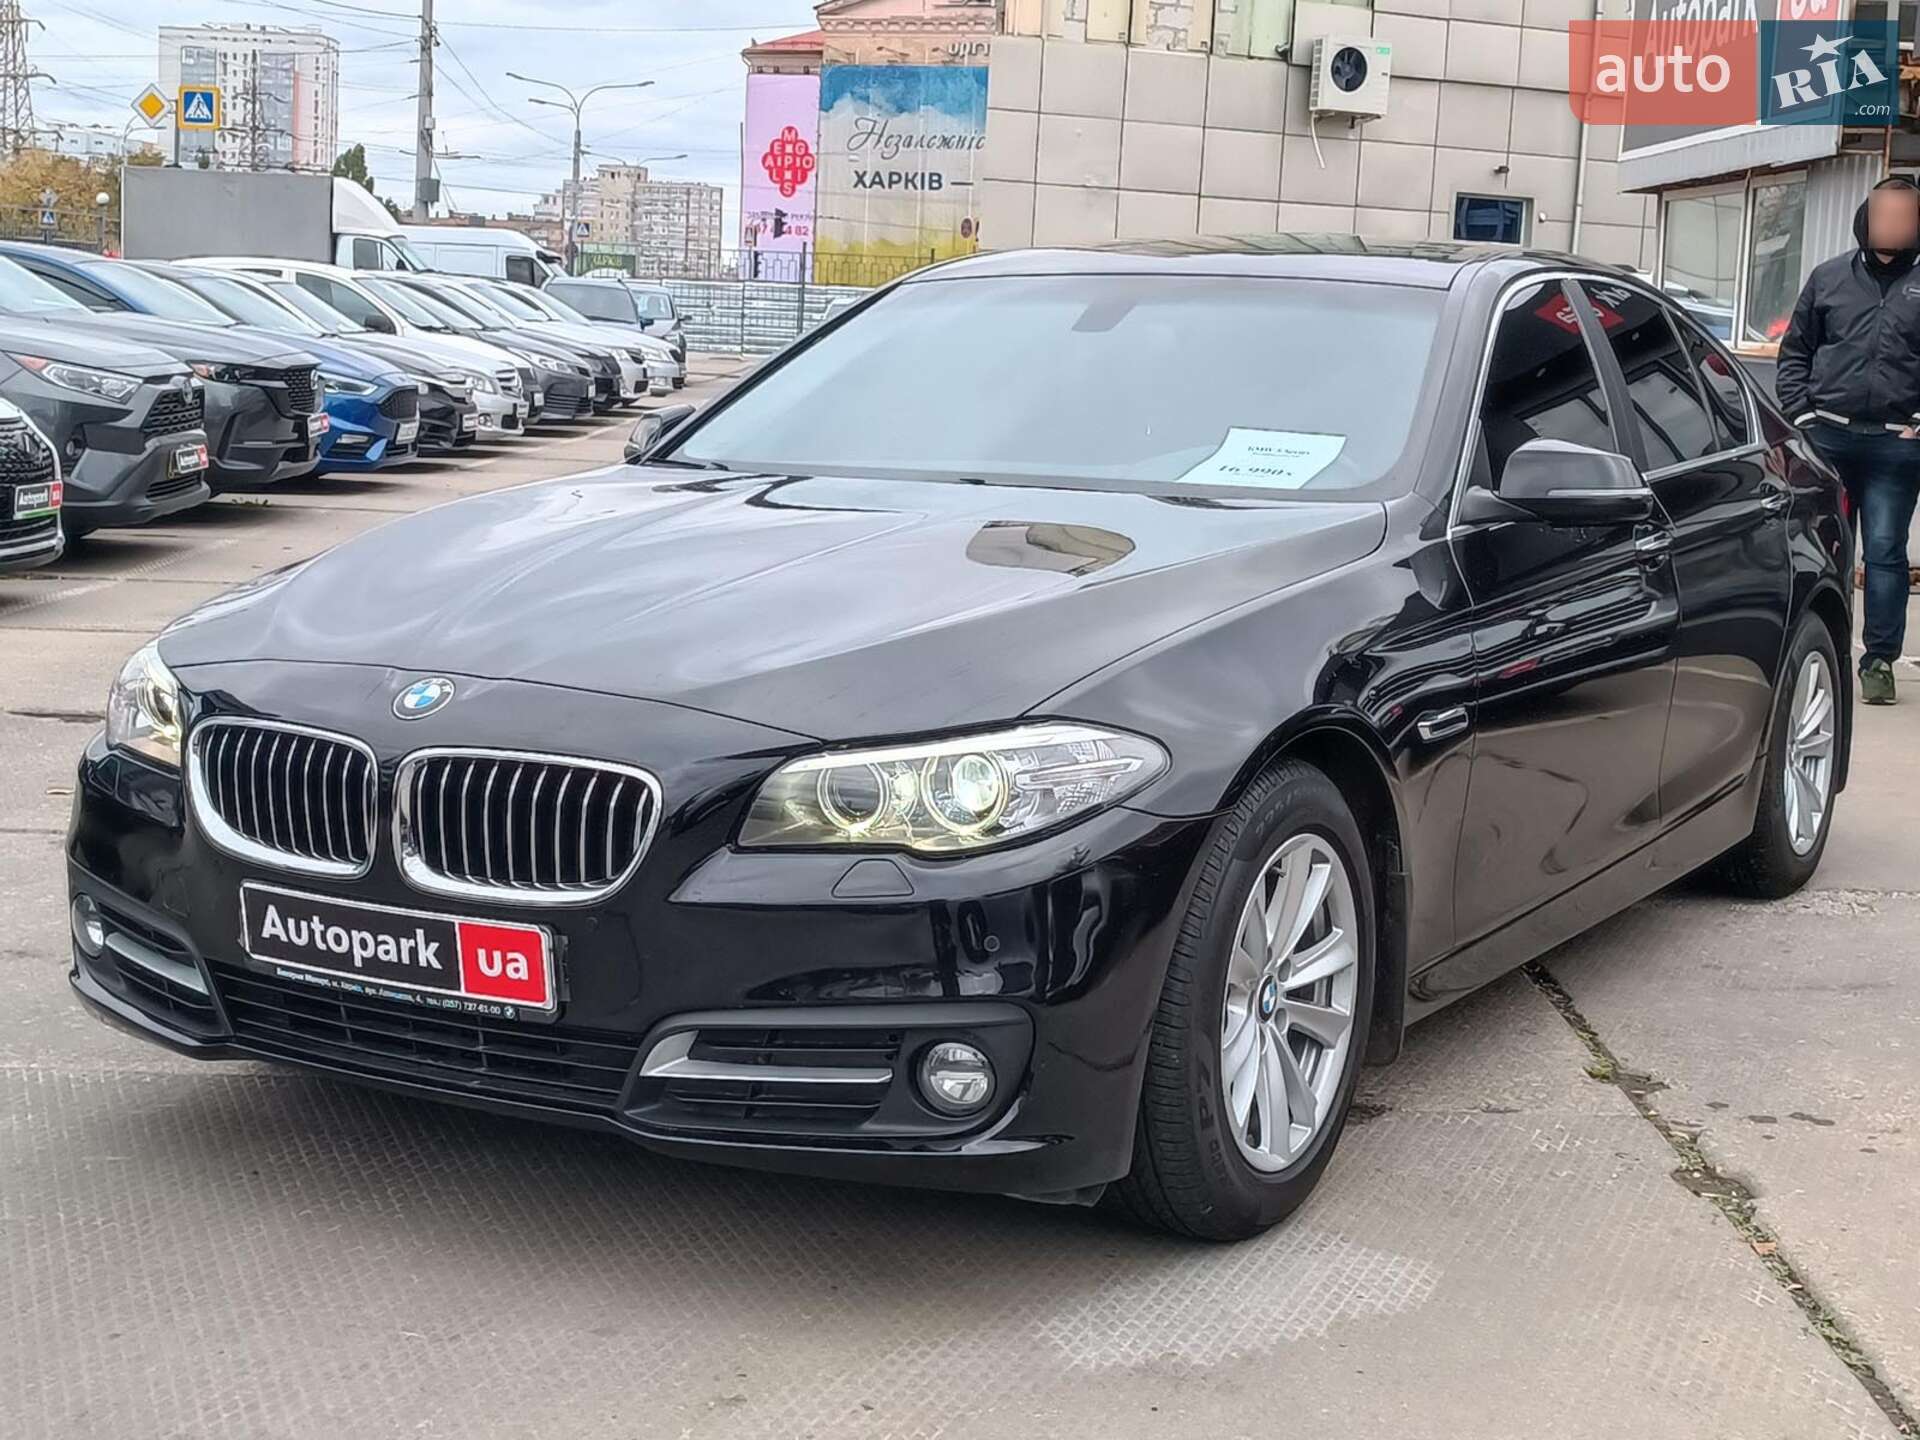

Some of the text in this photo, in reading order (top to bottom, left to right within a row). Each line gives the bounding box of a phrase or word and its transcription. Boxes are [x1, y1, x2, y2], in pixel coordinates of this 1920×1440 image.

[853, 169, 943, 191] ХАРКІВ
[261, 903, 529, 981] Autopark ua
